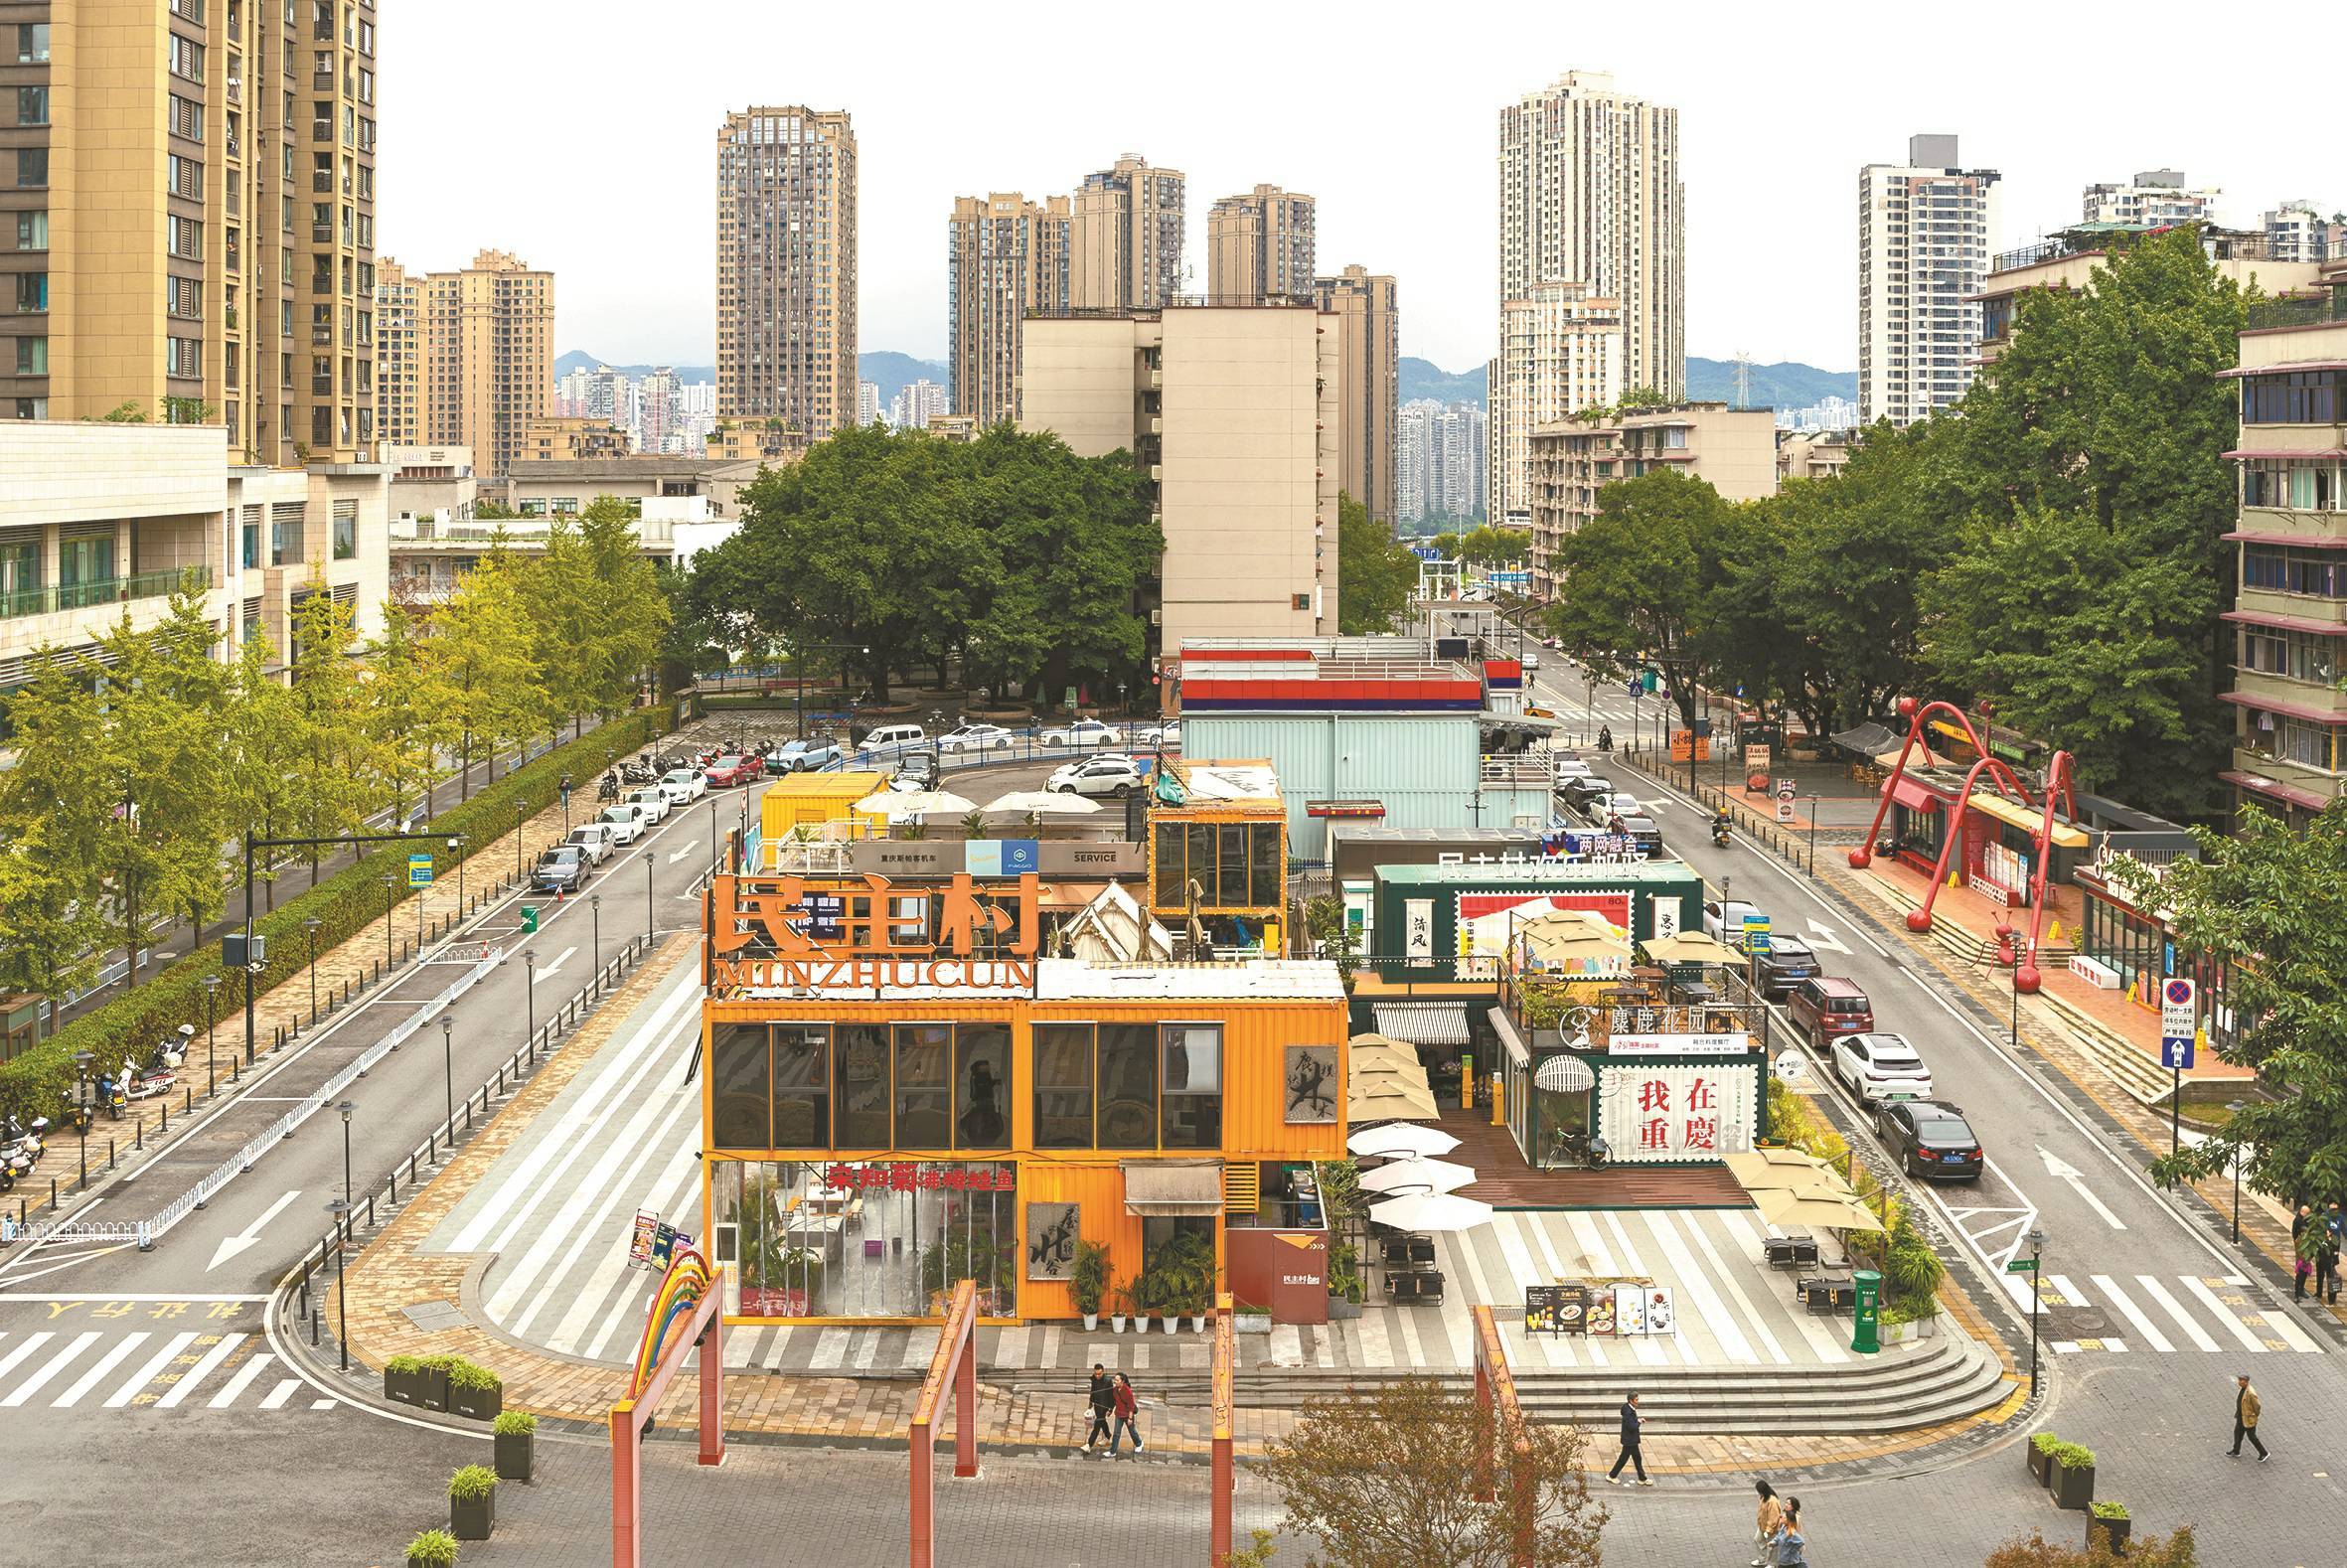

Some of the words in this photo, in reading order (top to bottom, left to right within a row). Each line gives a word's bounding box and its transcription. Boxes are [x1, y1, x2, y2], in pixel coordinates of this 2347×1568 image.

[1579, 836, 1638, 853] 两网融合
[711, 872, 1053, 955] 民主村
[1411, 915, 1428, 947] 清风
[711, 958, 1034, 990] MINZHUCUN
[1611, 1006, 1706, 1034] 麋鹿花园
[48, 1302, 243, 1320] 礼让行人
